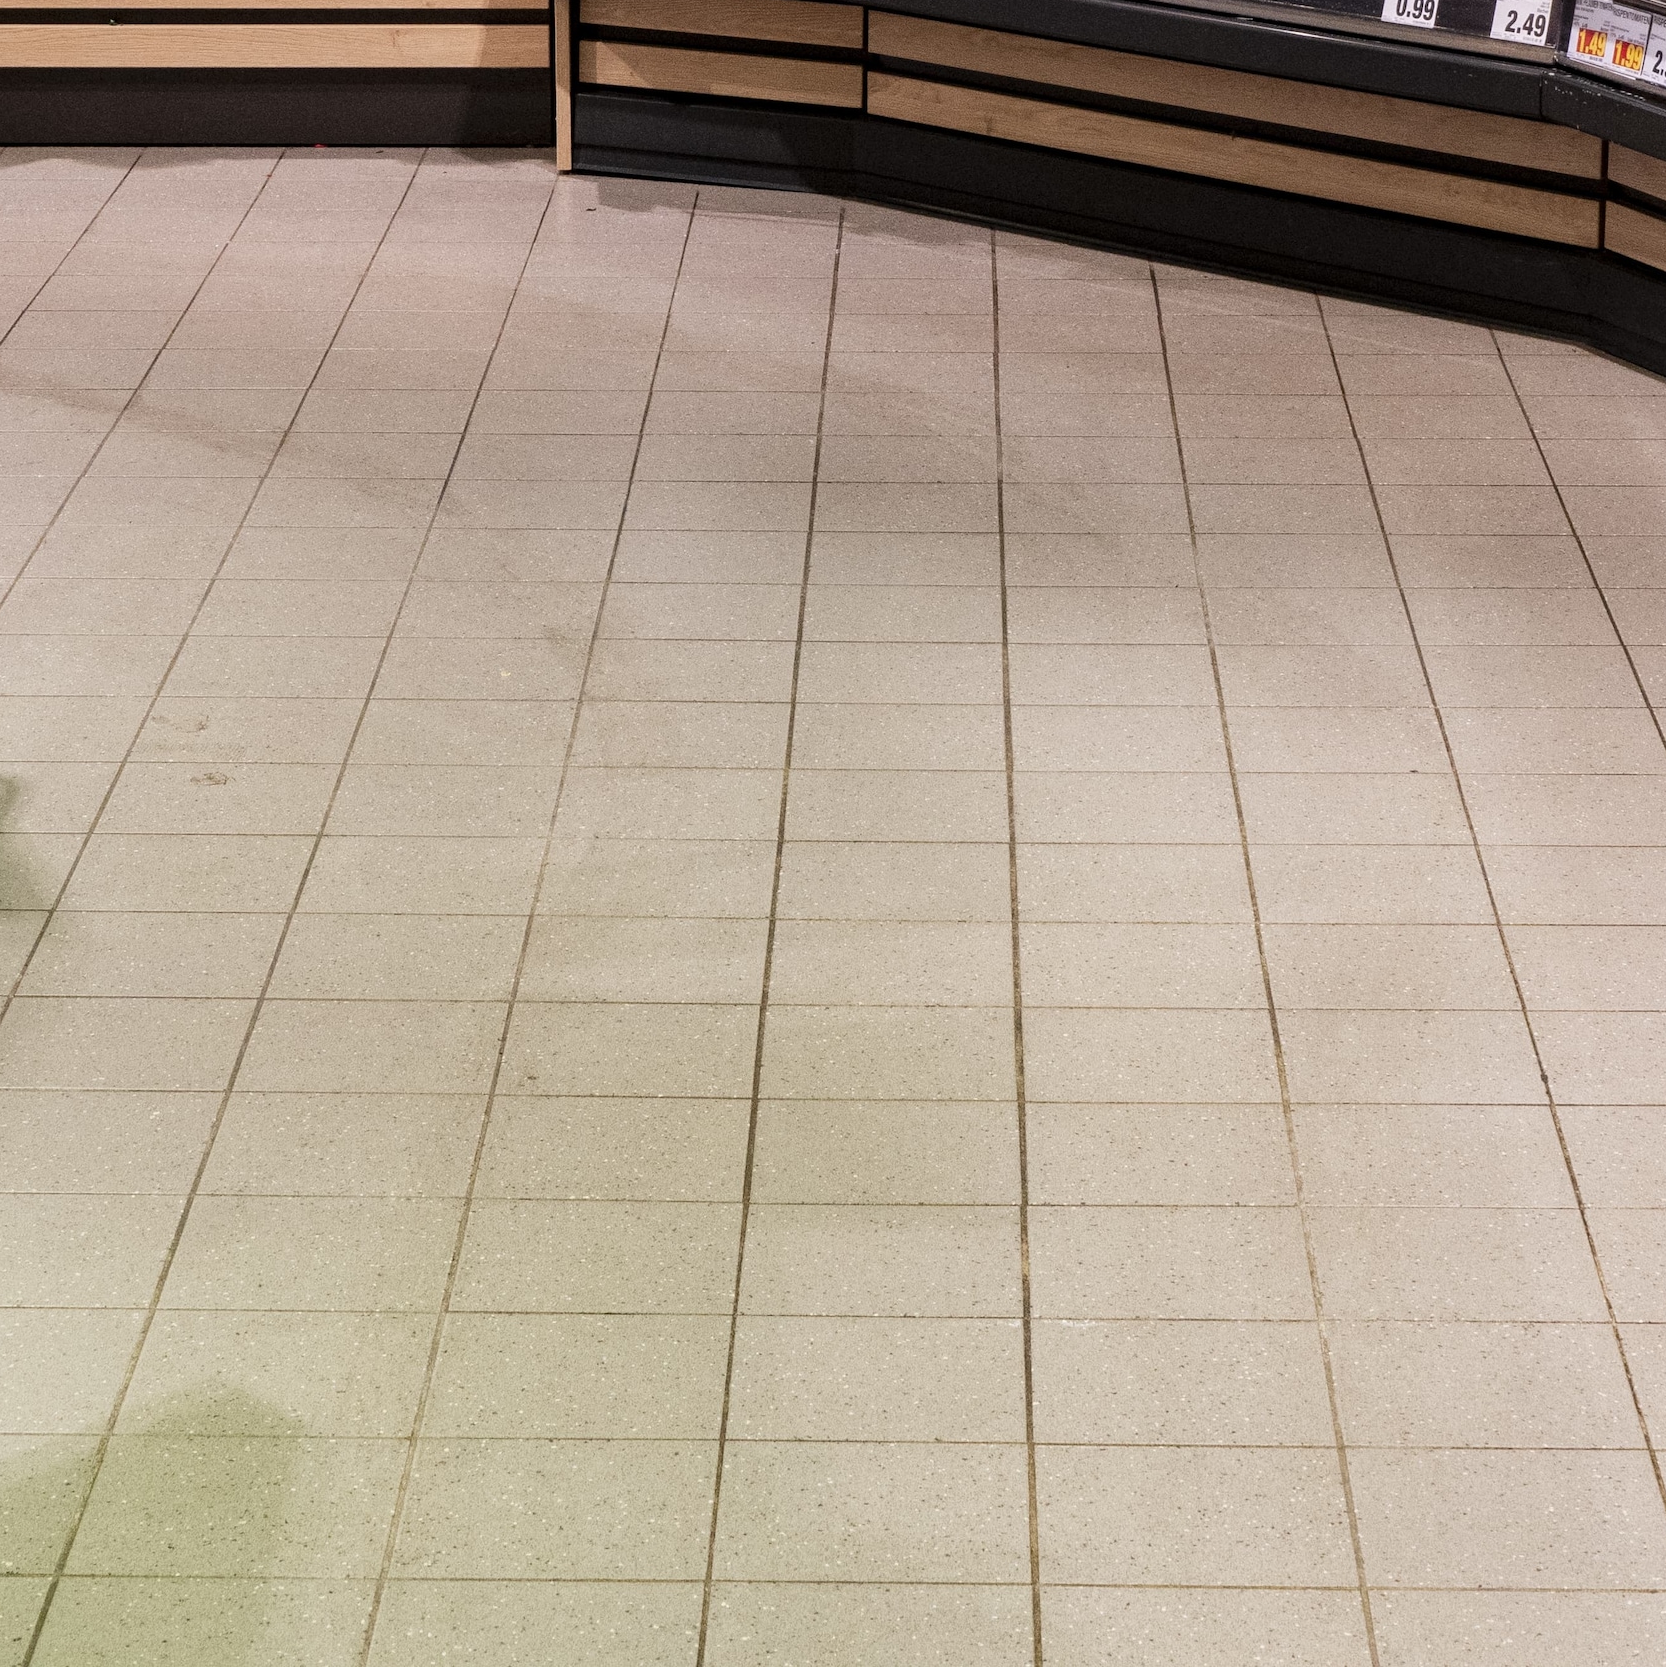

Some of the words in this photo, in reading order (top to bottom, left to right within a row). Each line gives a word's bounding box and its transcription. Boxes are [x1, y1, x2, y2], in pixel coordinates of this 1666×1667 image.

[1505, 10, 1546, 37] 2.49
[1579, 28, 1607, 57] 1.49
[1614, 41, 1644, 71] 1.99
